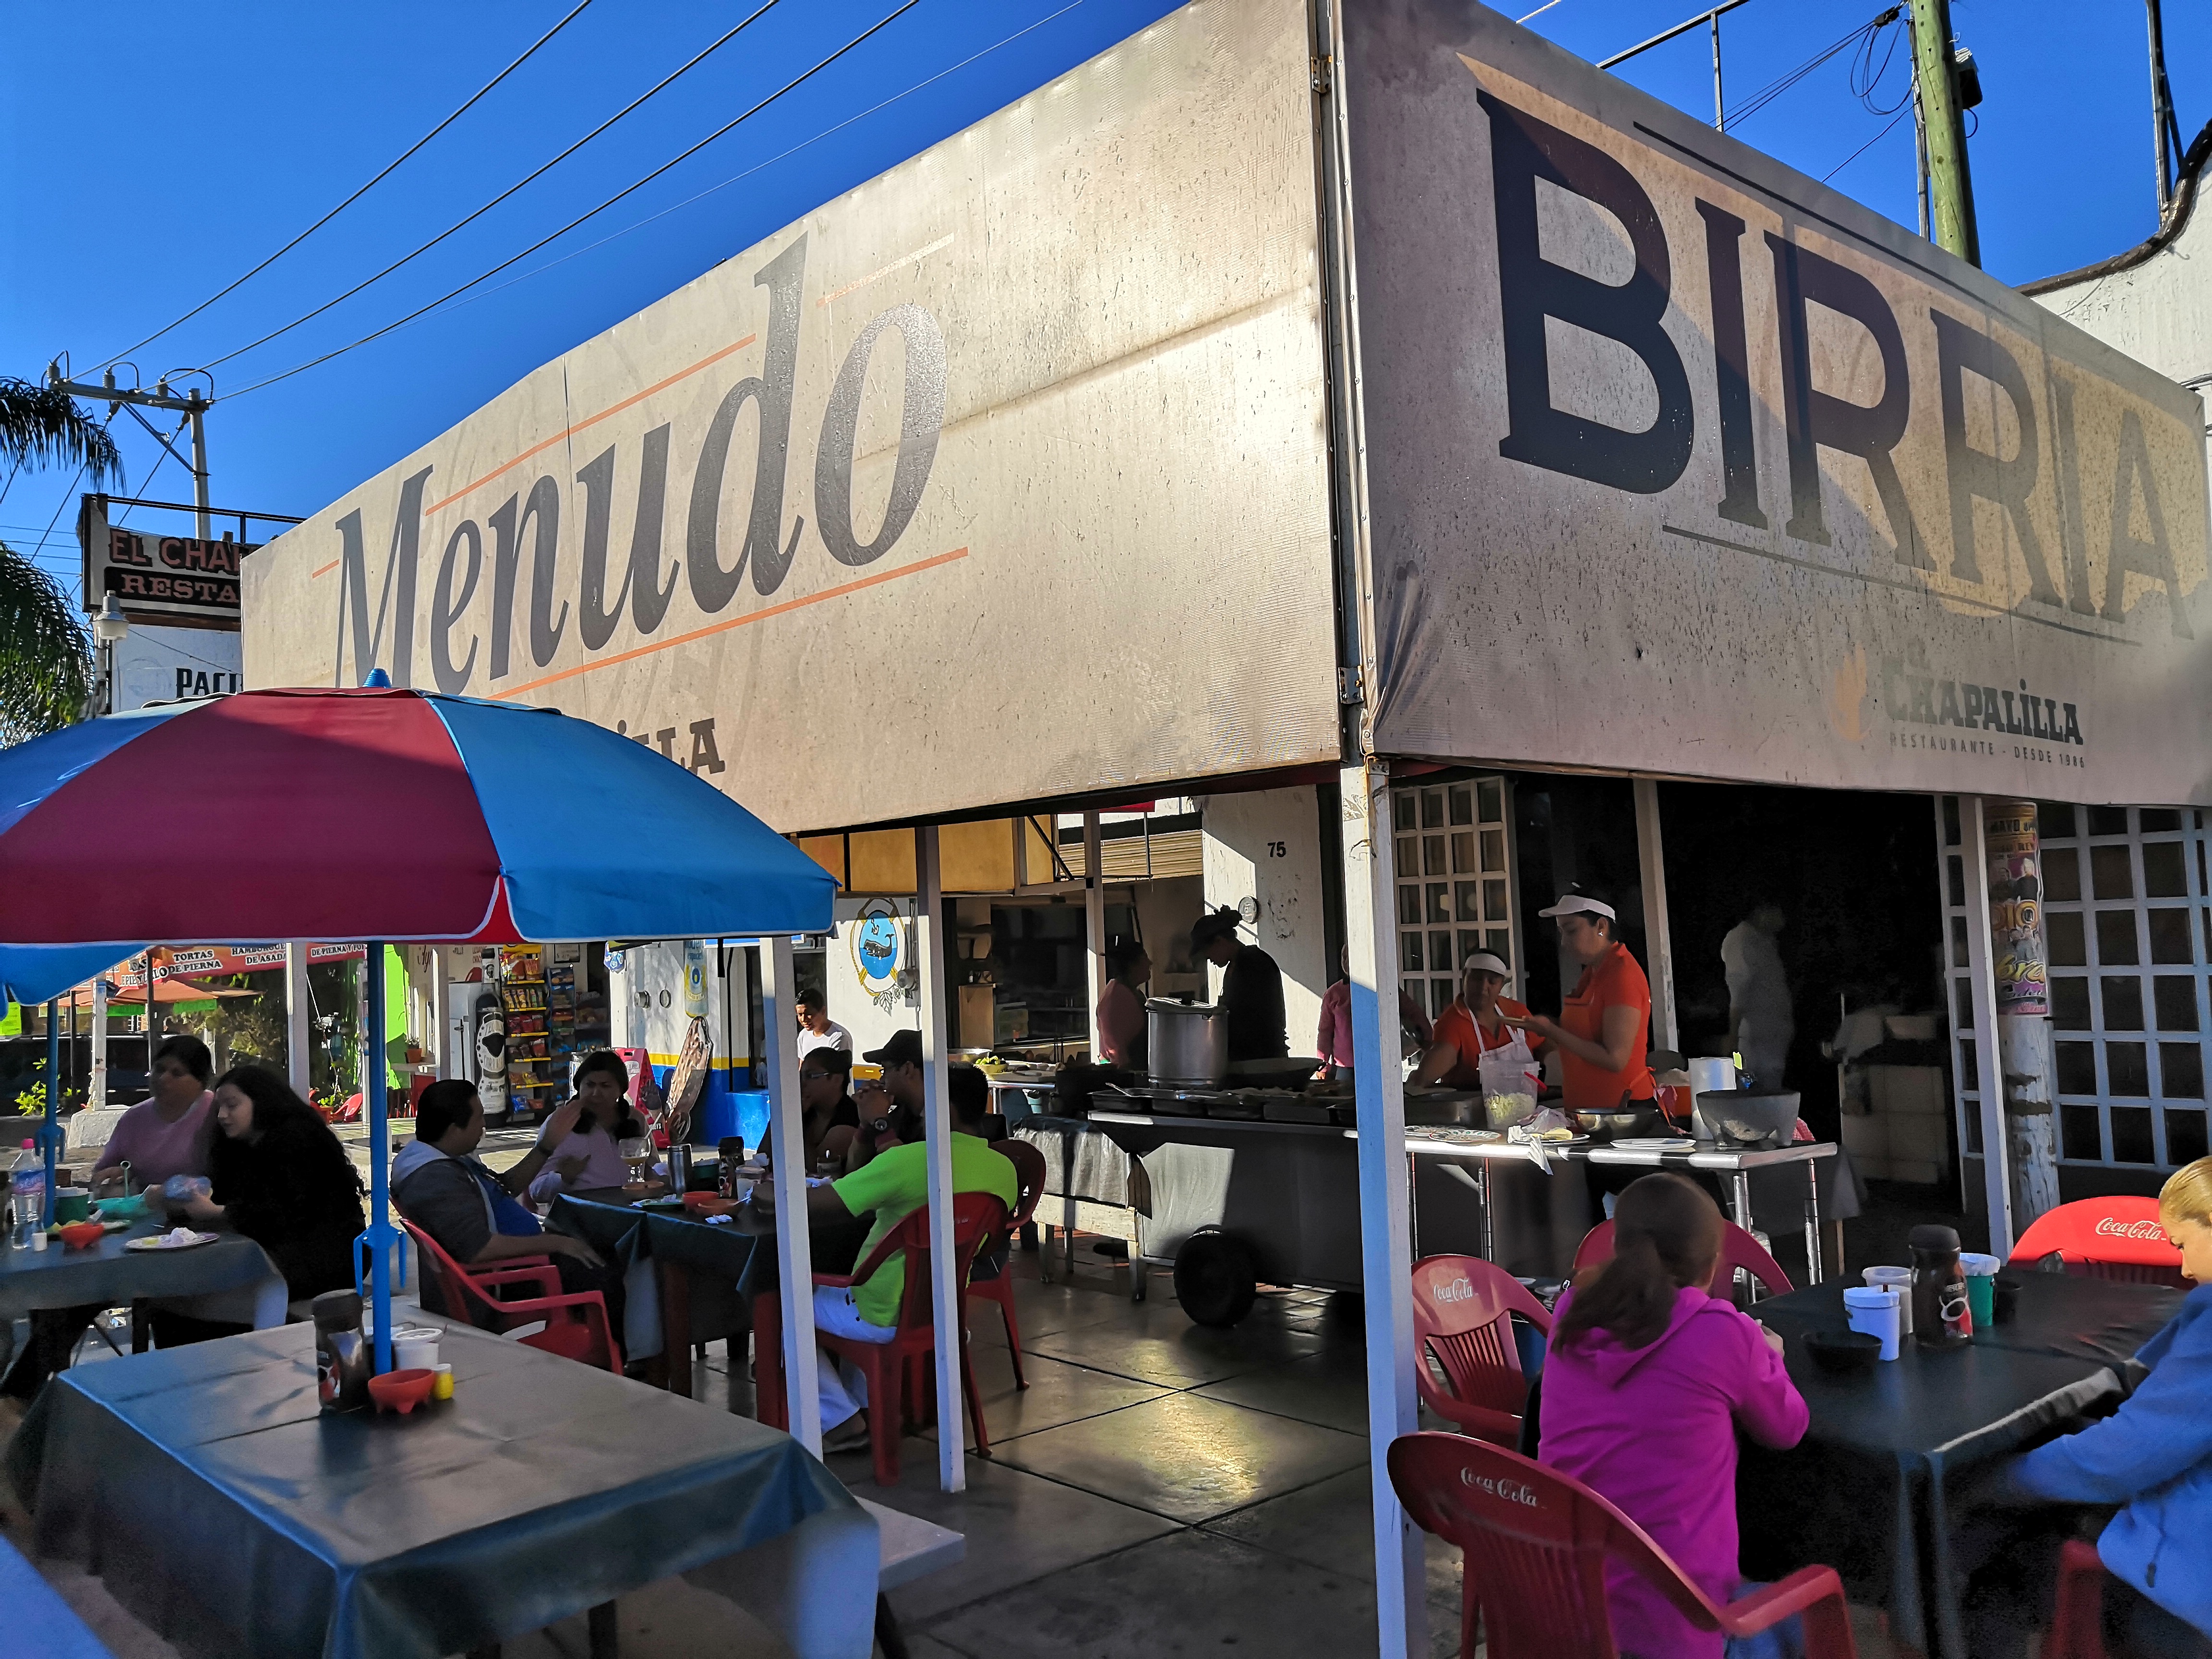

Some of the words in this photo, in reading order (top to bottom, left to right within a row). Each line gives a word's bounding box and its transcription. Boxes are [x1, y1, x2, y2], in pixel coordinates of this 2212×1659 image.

[1476, 88, 2194, 639] BIRRIA
[335, 231, 948, 696] Menudo
[110, 529, 147, 564] EL
[177, 667, 243, 698] PACI
[1890, 732, 1995, 756] RESTAURANTE
[2014, 745, 2052, 763] DESDE
[2058, 753, 2085, 768] 1986
[1267, 841, 1286, 858] 75
[174, 950, 213, 962] TORTAS
[321, 946, 346, 954] PIERNA
[168, 964, 182, 973] DE
[183, 961, 221, 971] PIERNA
[2095, 1217, 2162, 1240] Coca-Cola
